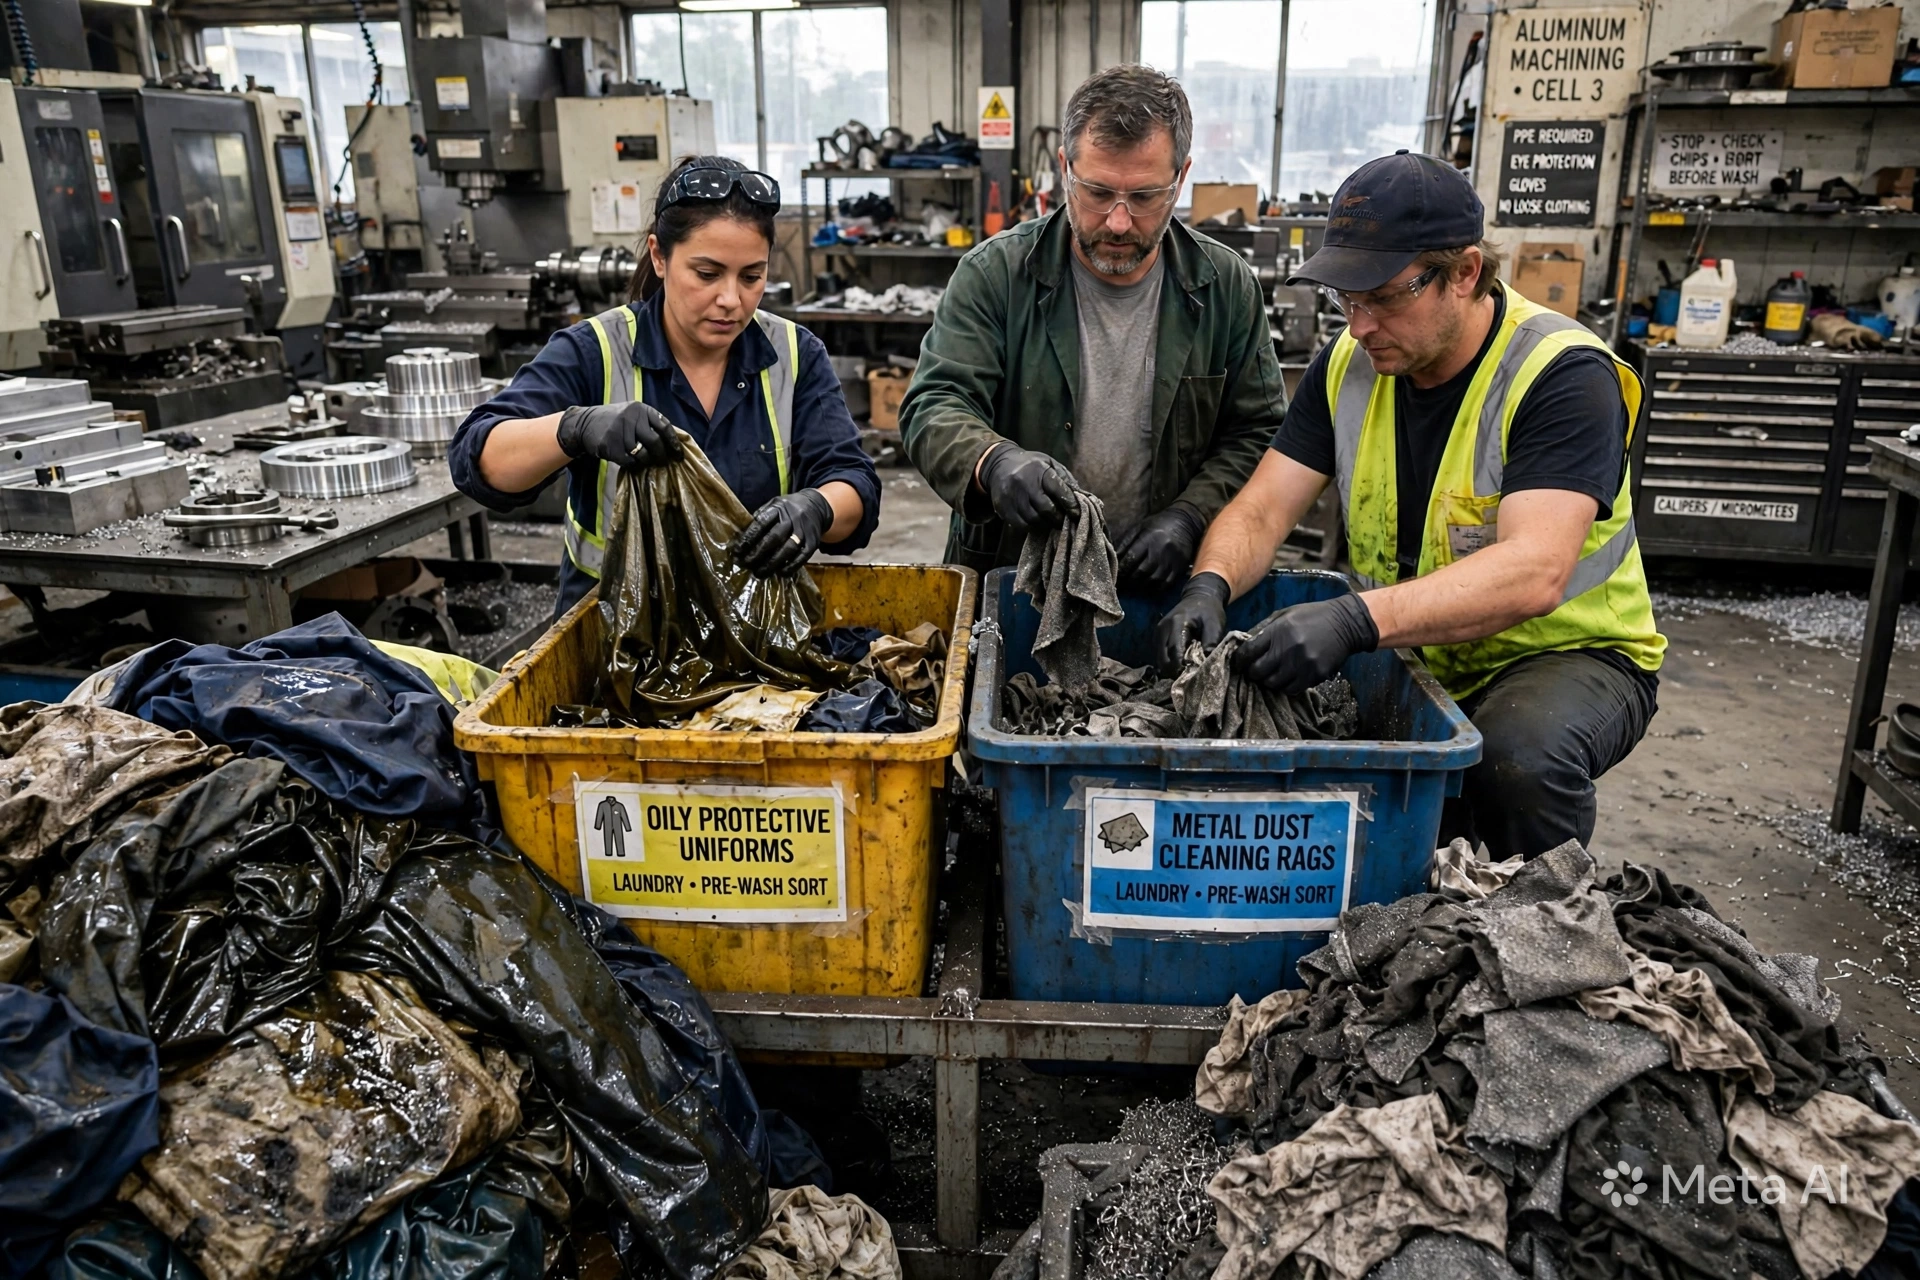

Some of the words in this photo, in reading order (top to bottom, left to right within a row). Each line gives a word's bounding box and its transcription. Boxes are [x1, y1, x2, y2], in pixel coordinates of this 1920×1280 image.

[1515, 18, 1626, 41] ALUMINUM
[1510, 47, 1625, 71] MACHINING
[1532, 79, 1581, 101] CELL
[1591, 78, 1604, 101] 3
[1513, 128, 1536, 144] PPE
[1538, 128, 1594, 144] REQUIRED
[1671, 134, 1705, 149] STOP
[1721, 134, 1766, 149] CHECK
[1510, 154, 1530, 170] EYE
[1532, 153, 1597, 170] PROTECTION
[1670, 152, 1709, 167] CHIPS
[1508, 177, 1547, 193] GLOVES
[1669, 170, 1717, 185] BEFORE
[1721, 170, 1759, 185] WASH
[1513, 199, 1543, 215] LOOSE
[1545, 199, 1591, 215] CLOTHING
[1657, 498, 1708, 513] CALIPERS
[647, 804, 692, 831] OILY
[699, 806, 831, 834] PROTECTIVE
[1172, 812, 1246, 840] METAL
[1254, 813, 1314, 840] DUST
[679, 836, 794, 864] UNIFORMS
[1159, 843, 1269, 870] CLEANING
[1276, 844, 1336, 871] RAGS
[613, 872, 684, 894] LAUNDRY
[701, 876, 783, 896] PRE-WASH
[788, 877, 828, 896] SORT
[1116, 881, 1189, 903] LAUNDRY
[1207, 884, 1290, 904] PRE-WASH
[1295, 885, 1336, 904] SORT
